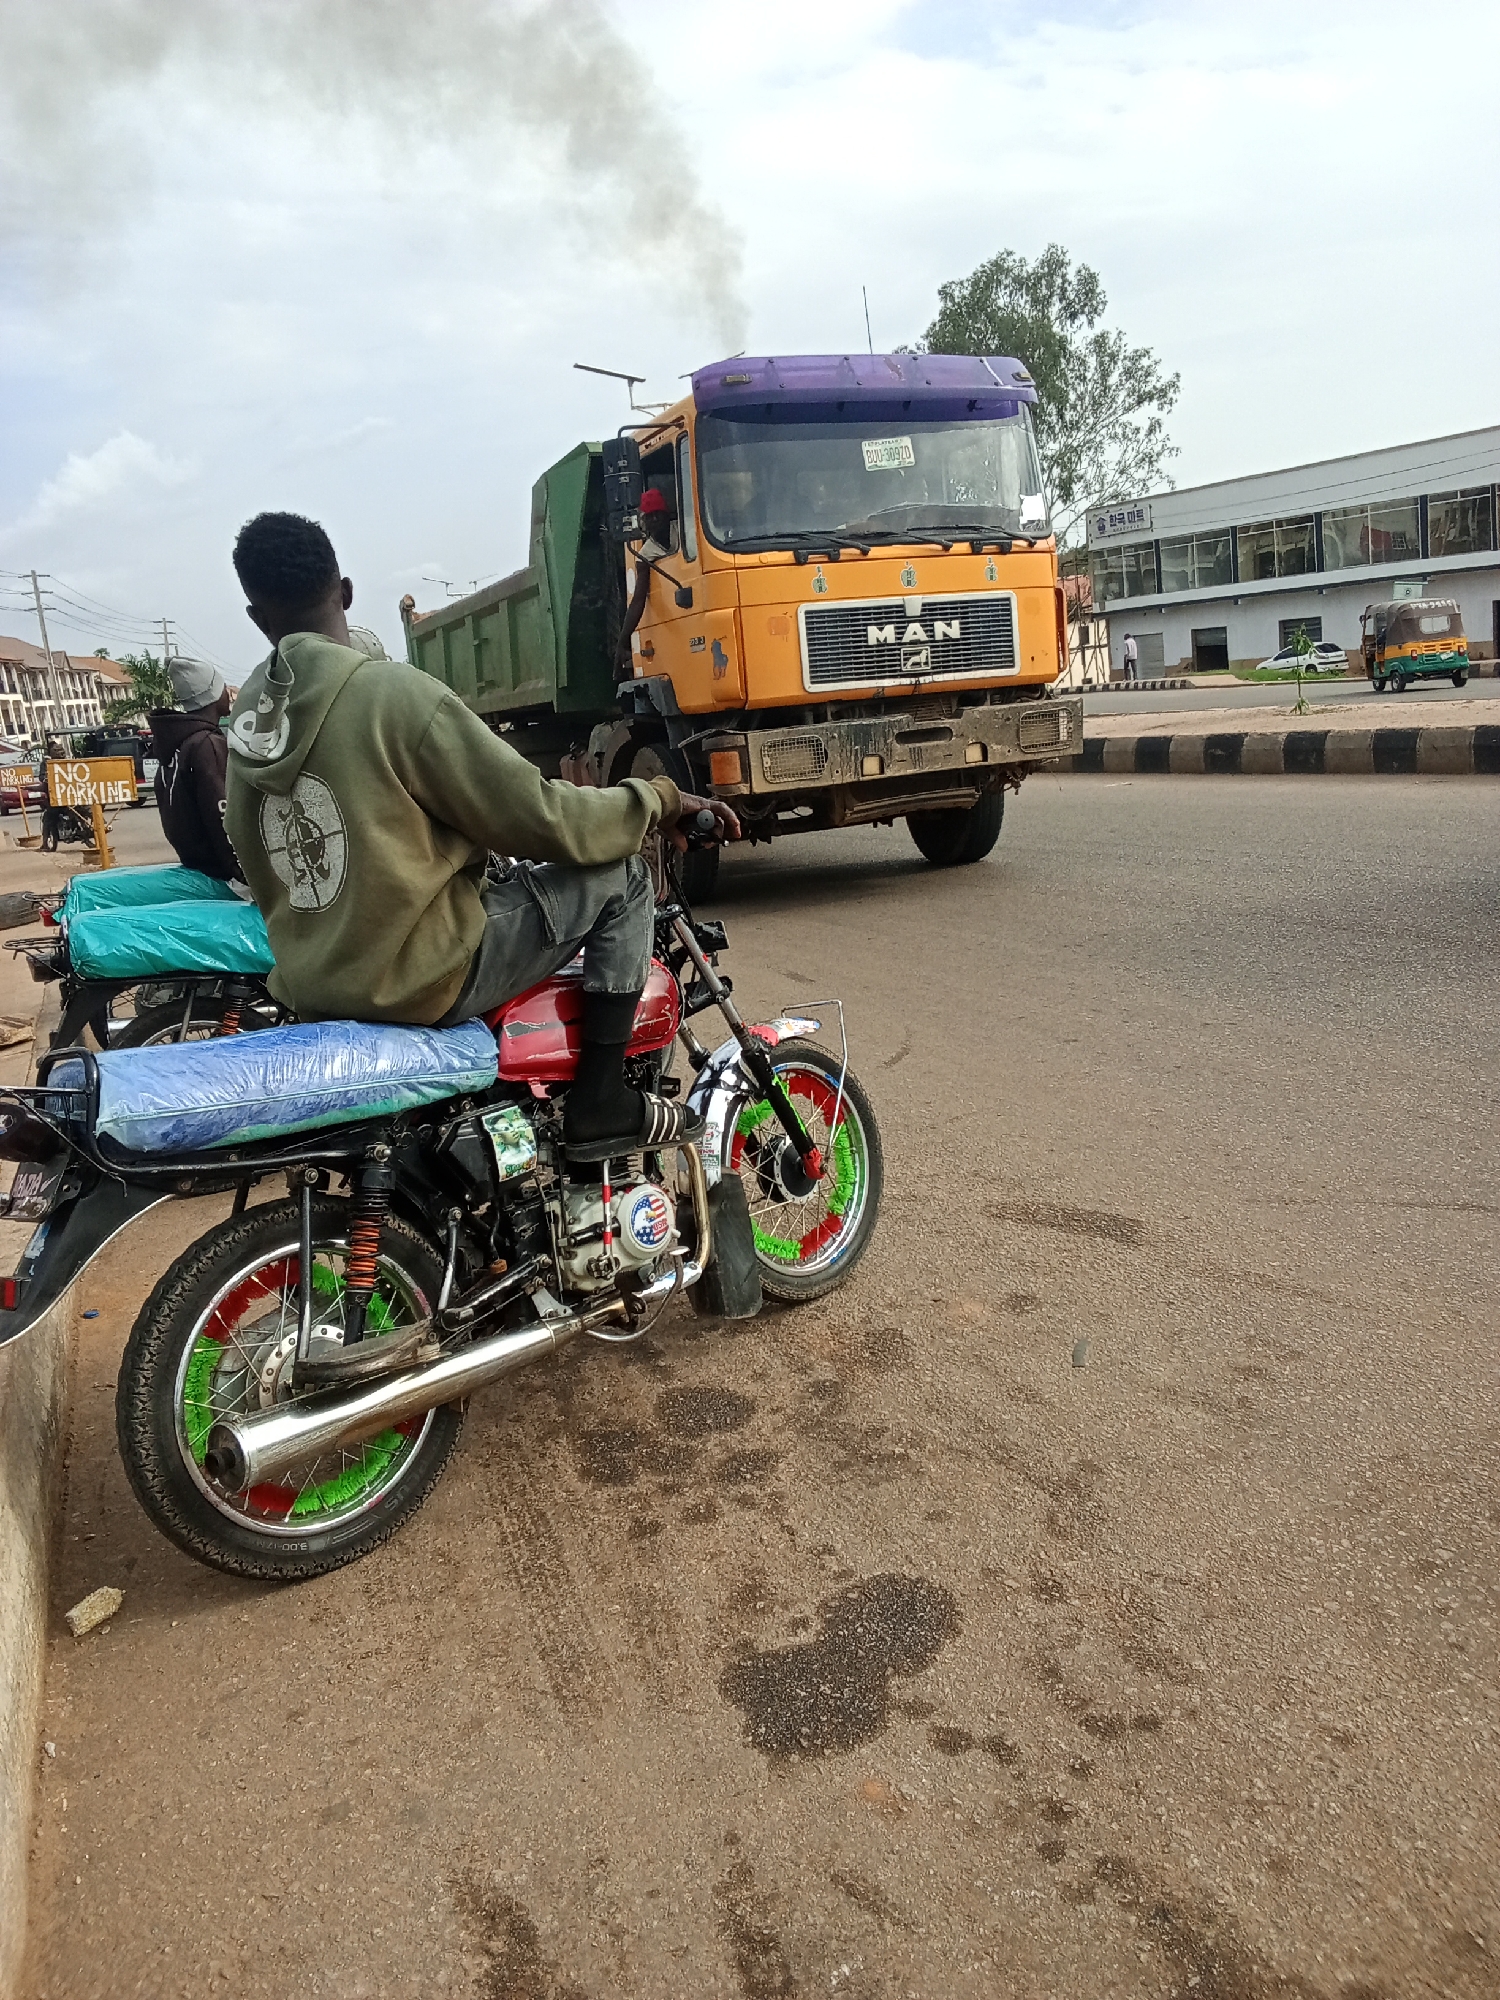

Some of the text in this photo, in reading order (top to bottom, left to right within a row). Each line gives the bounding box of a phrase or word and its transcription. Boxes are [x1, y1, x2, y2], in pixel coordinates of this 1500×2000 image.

[867, 620, 960, 645] MAN
[0, 768, 16, 779] NO
[1, 774, 33, 787] PARKING
[53, 763, 90, 782] NO
[54, 781, 131, 806] PARKING
